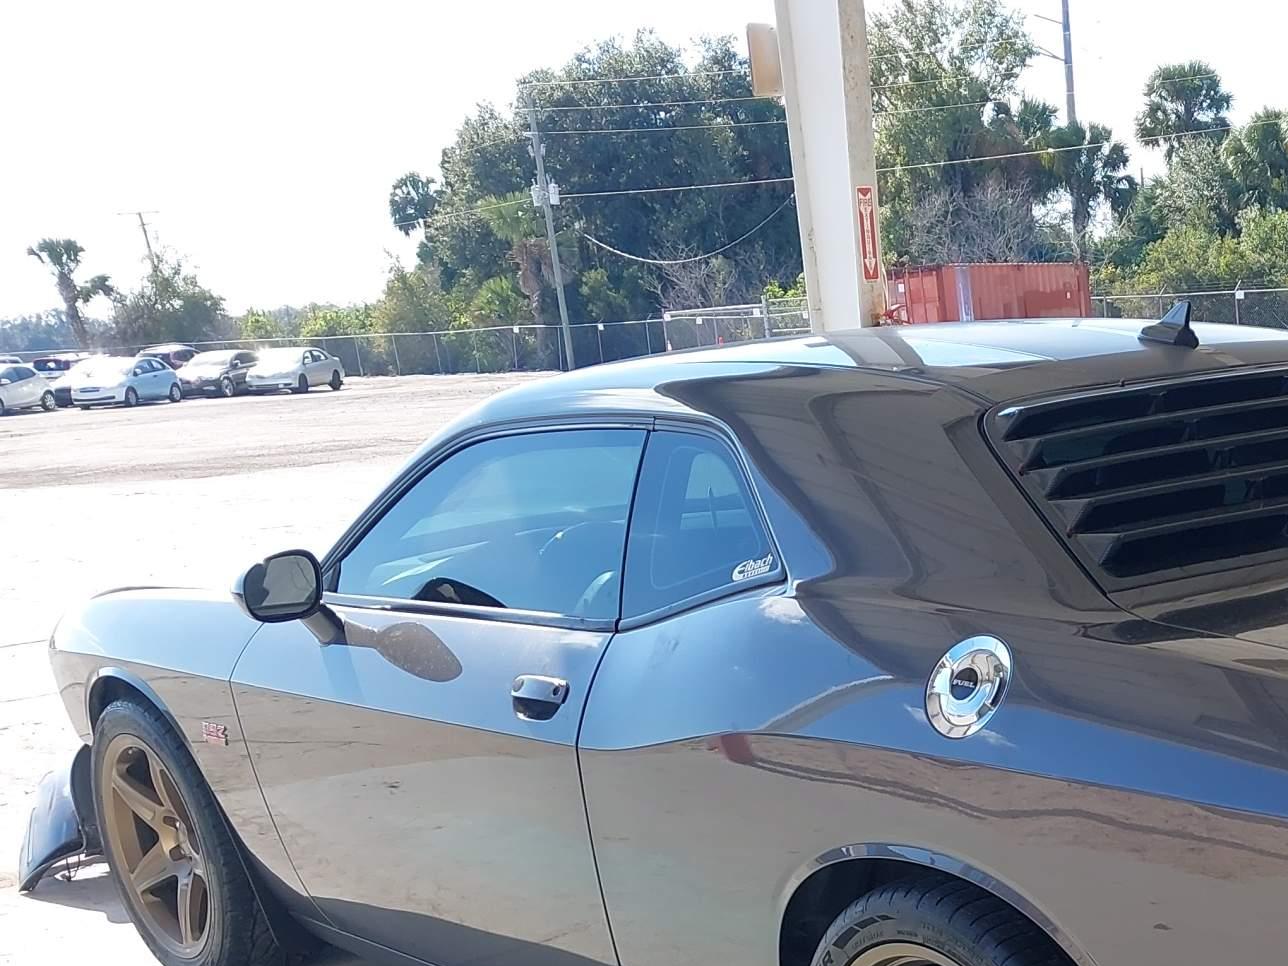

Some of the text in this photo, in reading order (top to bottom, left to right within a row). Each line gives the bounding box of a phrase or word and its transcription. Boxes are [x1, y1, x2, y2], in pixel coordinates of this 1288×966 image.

[859, 198, 872, 206] FIRE
[732, 553, 773, 580] Eibach
[953, 679, 975, 688] FUEL
